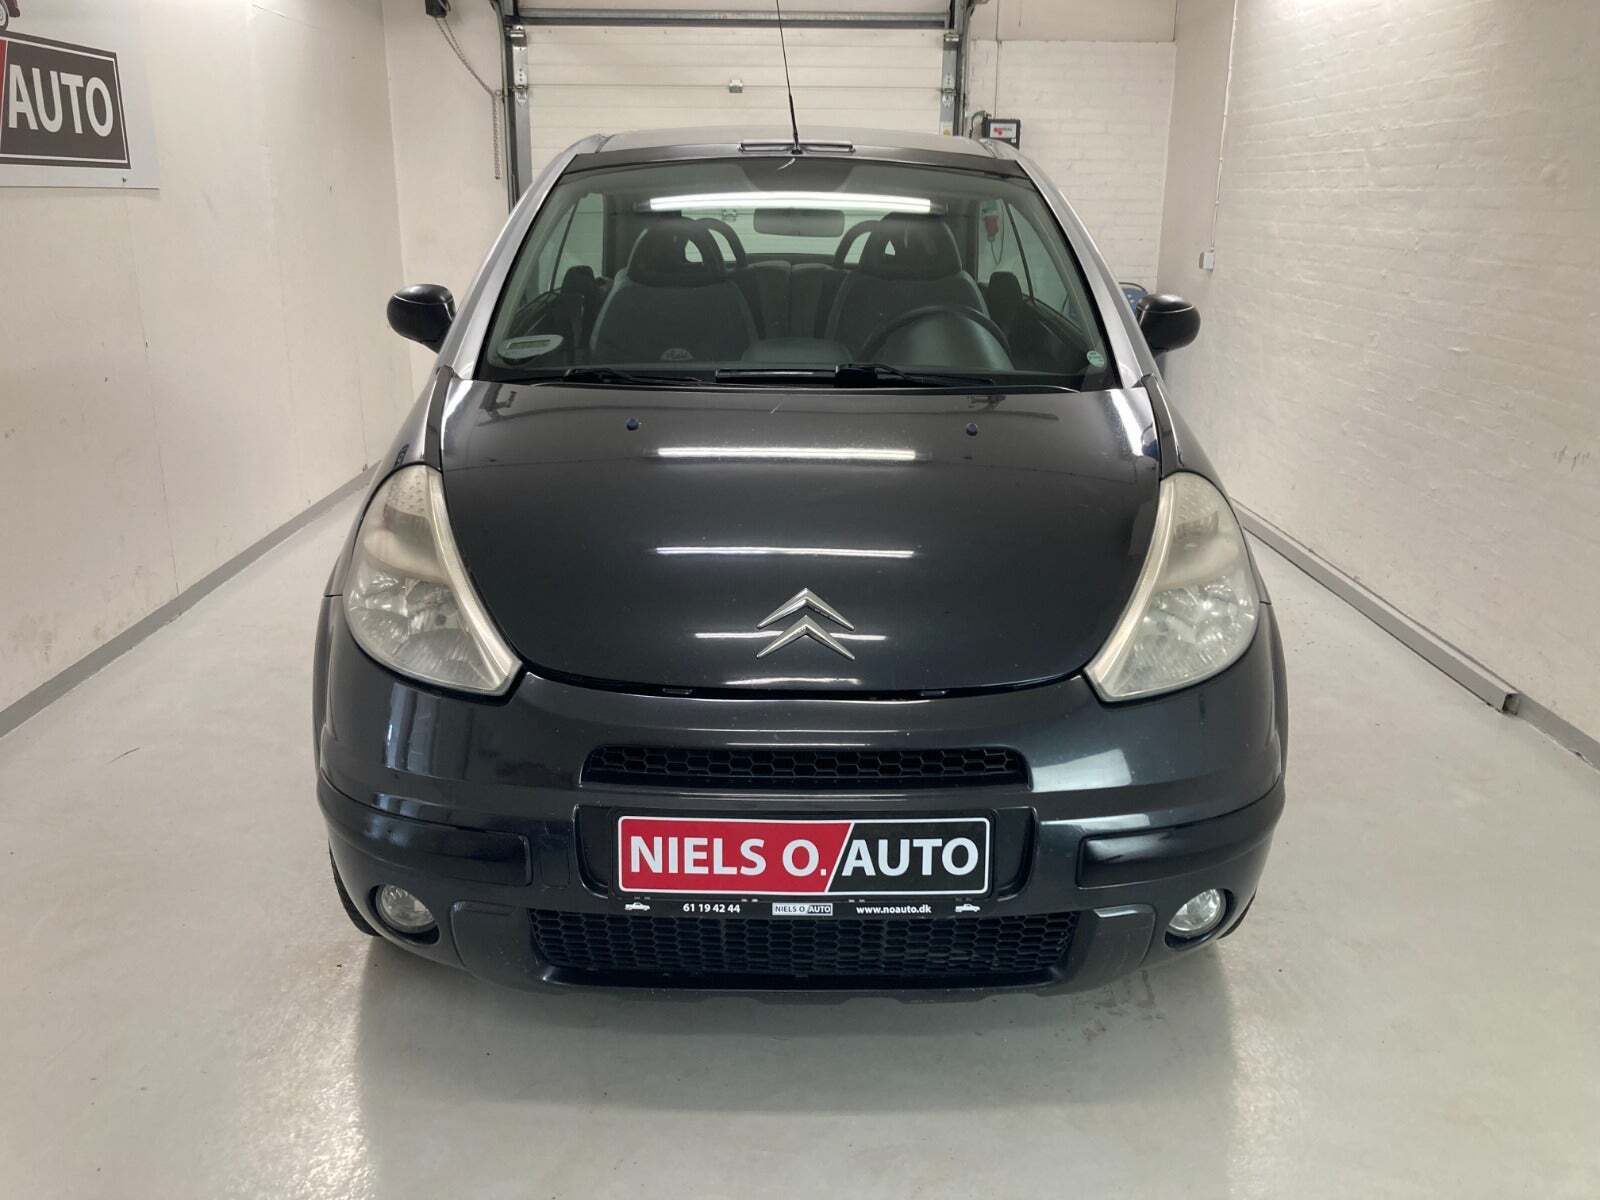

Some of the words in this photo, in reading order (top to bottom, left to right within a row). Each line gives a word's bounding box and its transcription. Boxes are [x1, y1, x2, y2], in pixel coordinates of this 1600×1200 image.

[8, 64, 114, 137] AUTO
[630, 835, 767, 875] NIELS
[782, 839, 827, 877] O.
[842, 838, 979, 877] AUTO
[683, 903, 695, 912] 61
[698, 903, 711, 913] 19
[712, 904, 726, 913] 42
[727, 904, 741, 913] 44
[775, 905, 797, 913] NIELS
[808, 905, 831, 913] AUTO
[856, 904, 932, 914] www.noauto.dk
